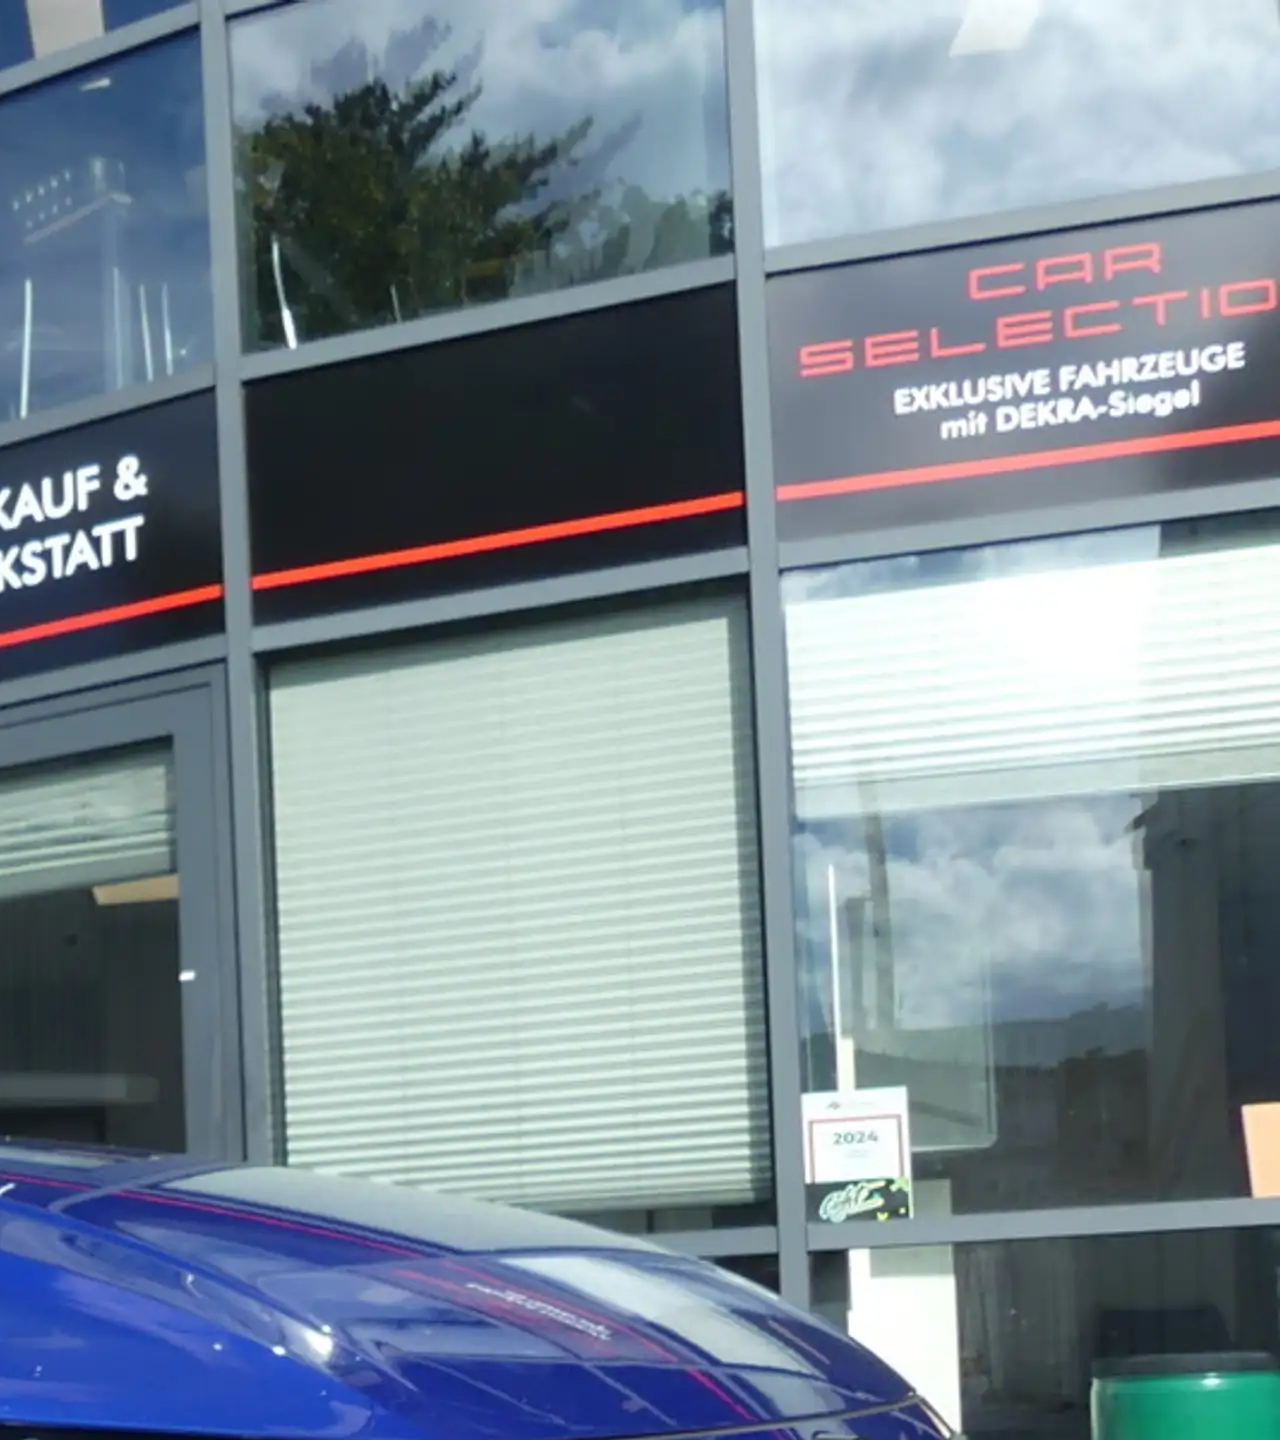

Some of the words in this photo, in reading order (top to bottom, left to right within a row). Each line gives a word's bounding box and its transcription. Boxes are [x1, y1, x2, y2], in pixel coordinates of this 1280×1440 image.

[967, 242, 1162, 301] CAR
[798, 278, 1278, 378] SELECTIO
[893, 368, 1052, 416] EXKLUSIVE
[1058, 341, 1246, 392] FAHRZEUGE
[940, 410, 988, 440] mit
[996, 380, 1201, 433] DEKRA-Siegel
[113, 455, 149, 501] &
[833, 1129, 879, 1146] 2024
